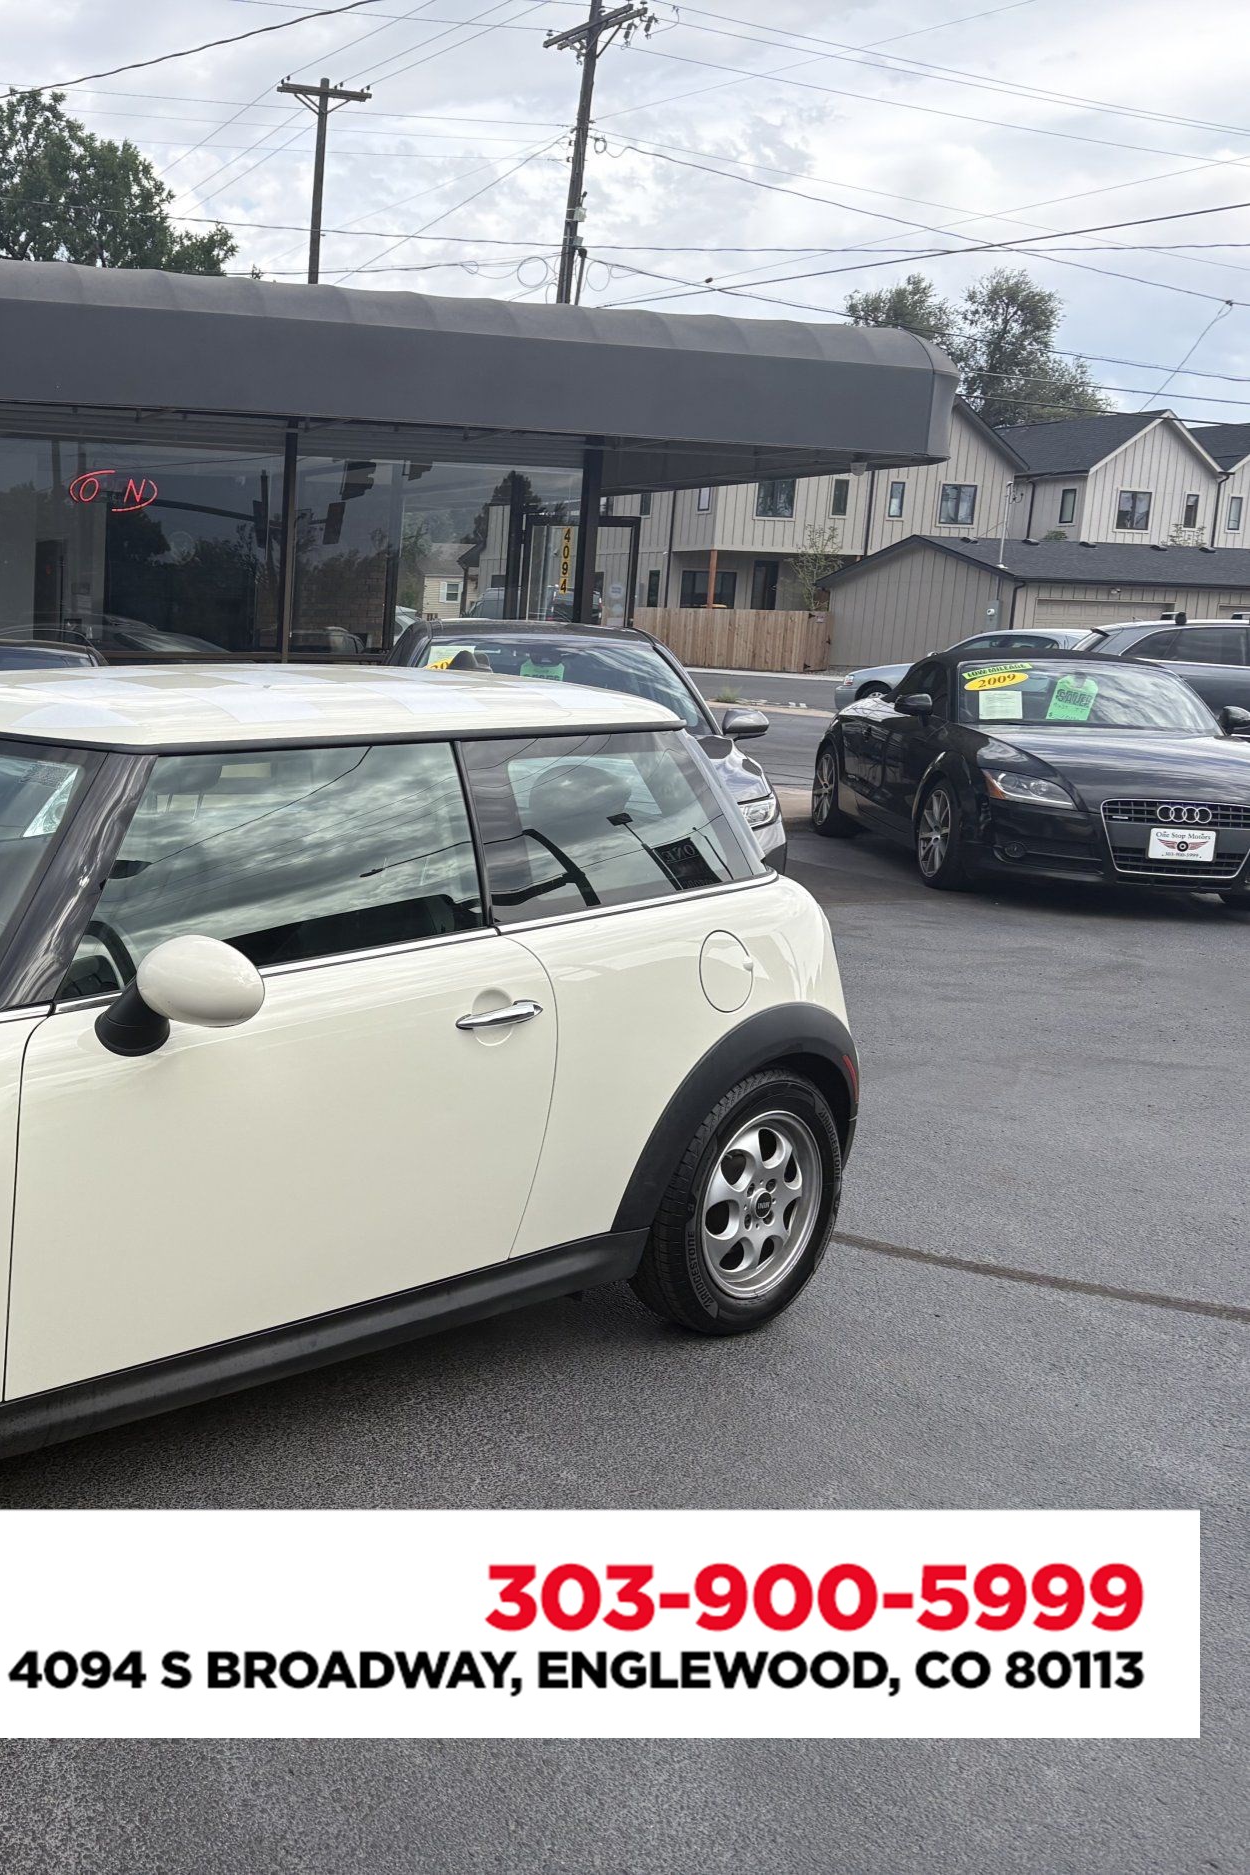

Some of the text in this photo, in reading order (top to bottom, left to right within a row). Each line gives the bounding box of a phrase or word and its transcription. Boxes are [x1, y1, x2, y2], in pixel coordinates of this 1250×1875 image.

[559, 527, 572, 594] 4094
[977, 673, 1016, 689] 2009
[1155, 831, 1211, 841] One Stop Motors
